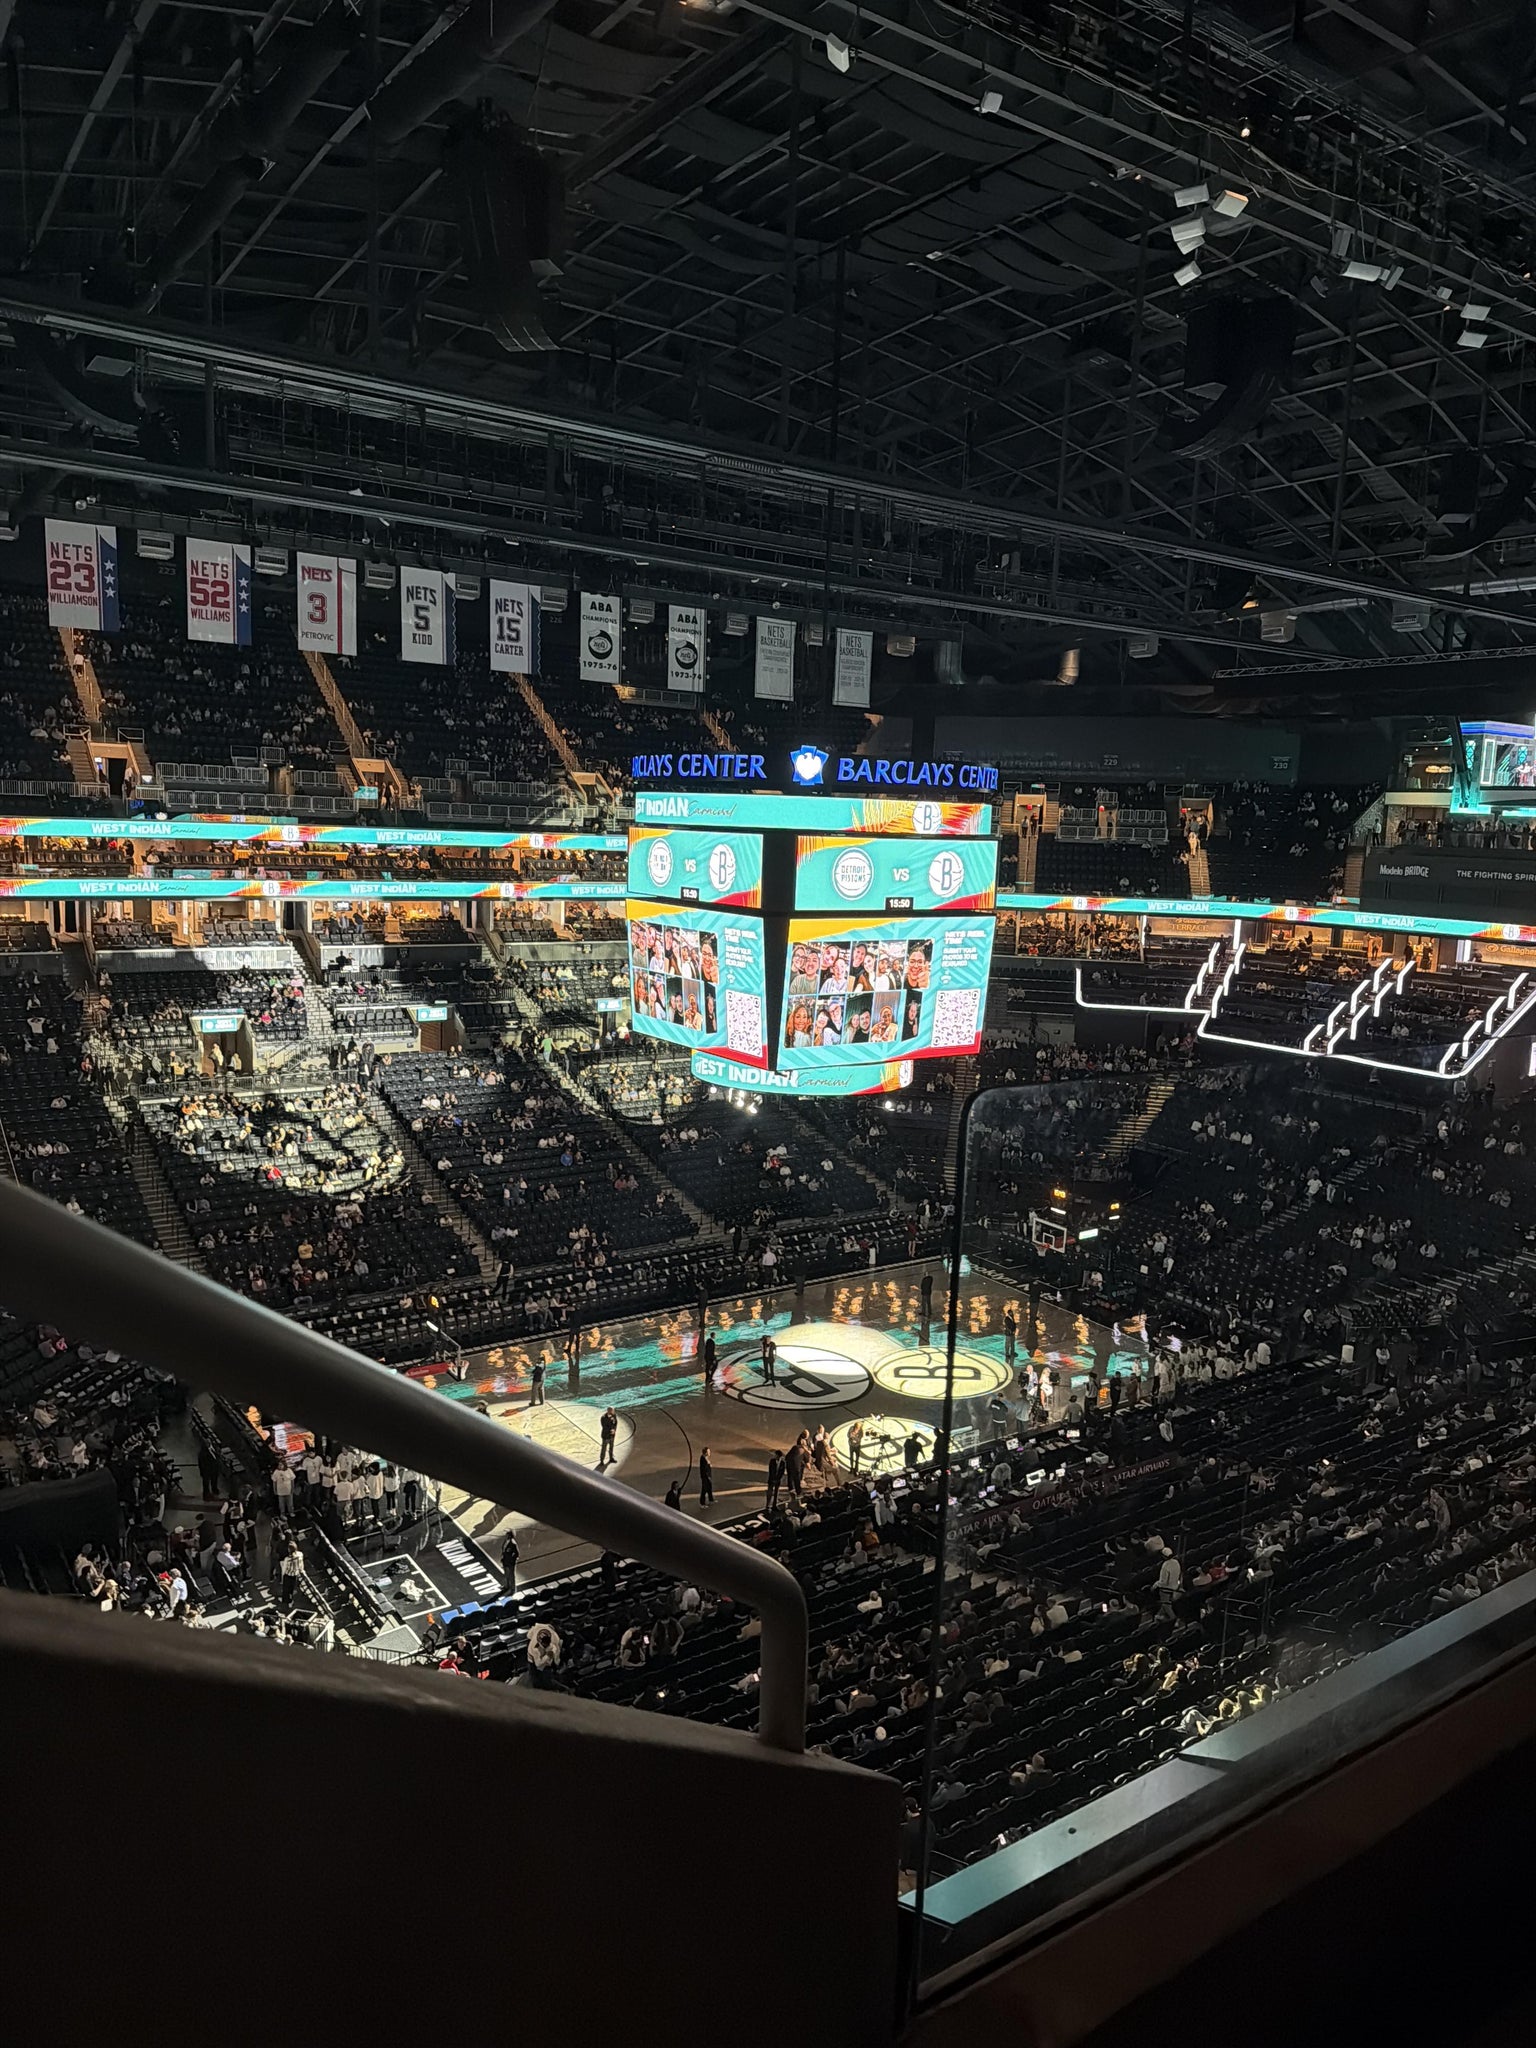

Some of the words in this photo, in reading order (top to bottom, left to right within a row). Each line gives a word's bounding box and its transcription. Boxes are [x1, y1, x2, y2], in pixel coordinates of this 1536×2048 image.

[50, 541, 93, 562] NETS
[190, 559, 229, 579] NETS
[301, 565, 333, 582] NETS
[50, 560, 95, 593] 23
[190, 577, 230, 608] 52
[406, 585, 437, 606] NETS
[49, 592, 98, 607] WILLIAMSON
[307, 592, 328, 624] 3
[495, 597, 524, 618] NETS
[589, 601, 613, 613] ABA
[190, 608, 231, 622] WILLIAMS
[413, 604, 430, 631] 5
[582, 614, 618, 625] CHAMPIONS
[677, 613, 699, 625] ABA
[301, 631, 335, 641] PETROVIC
[496, 616, 521, 643] 15
[671, 627, 702, 636] CHAMPIONS
[767, 625, 785, 638] NETS
[412, 633, 433, 645] KIDD
[760, 636, 791, 648] BASKETBALL
[845, 635, 862, 648] NETS
[494, 643, 524, 656] CARTER
[583, 661, 618, 671] 1975-76
[671, 670, 702, 680] 1973-74
[678, 754, 767, 779] CENTER
[837, 757, 954, 786] BARCLAYS
[646, 796, 689, 817] INDIAN
[92, 823, 126, 835] WEST
[129, 823, 172, 835] INDIAN
[376, 831, 405, 842] WEST
[407, 832, 442, 843] INDIAN
[841, 864, 866, 874] DETROIT
[893, 868, 910, 882] VS
[1379, 864, 1403, 876] Modelo
[1404, 865, 1430, 878] BRIDGE
[1456, 869, 1472, 878] THE
[1474, 870, 1513, 880] FIGHTING
[841, 874, 866, 883] PISTONS
[79, 882, 114, 894] WEST
[117, 882, 160, 893] INDIAN
[350, 883, 379, 894] WEST
[381, 883, 417, 893] INDIAN
[571, 885, 597, 895] WEST
[600, 885, 626, 894] INDIAN
[889, 898, 910, 908] 15:50
[1147, 901, 1173, 911] WEST
[1175, 902, 1209, 912] INDIAN
[1354, 914, 1379, 924] WEST
[1381, 917, 1414, 928] INDIAN
[728, 1066, 799, 1088] INDIAN
[894, 1364, 981, 1380] B
[456, 1561, 487, 1578] IN
[469, 1572, 503, 1596] ALL
